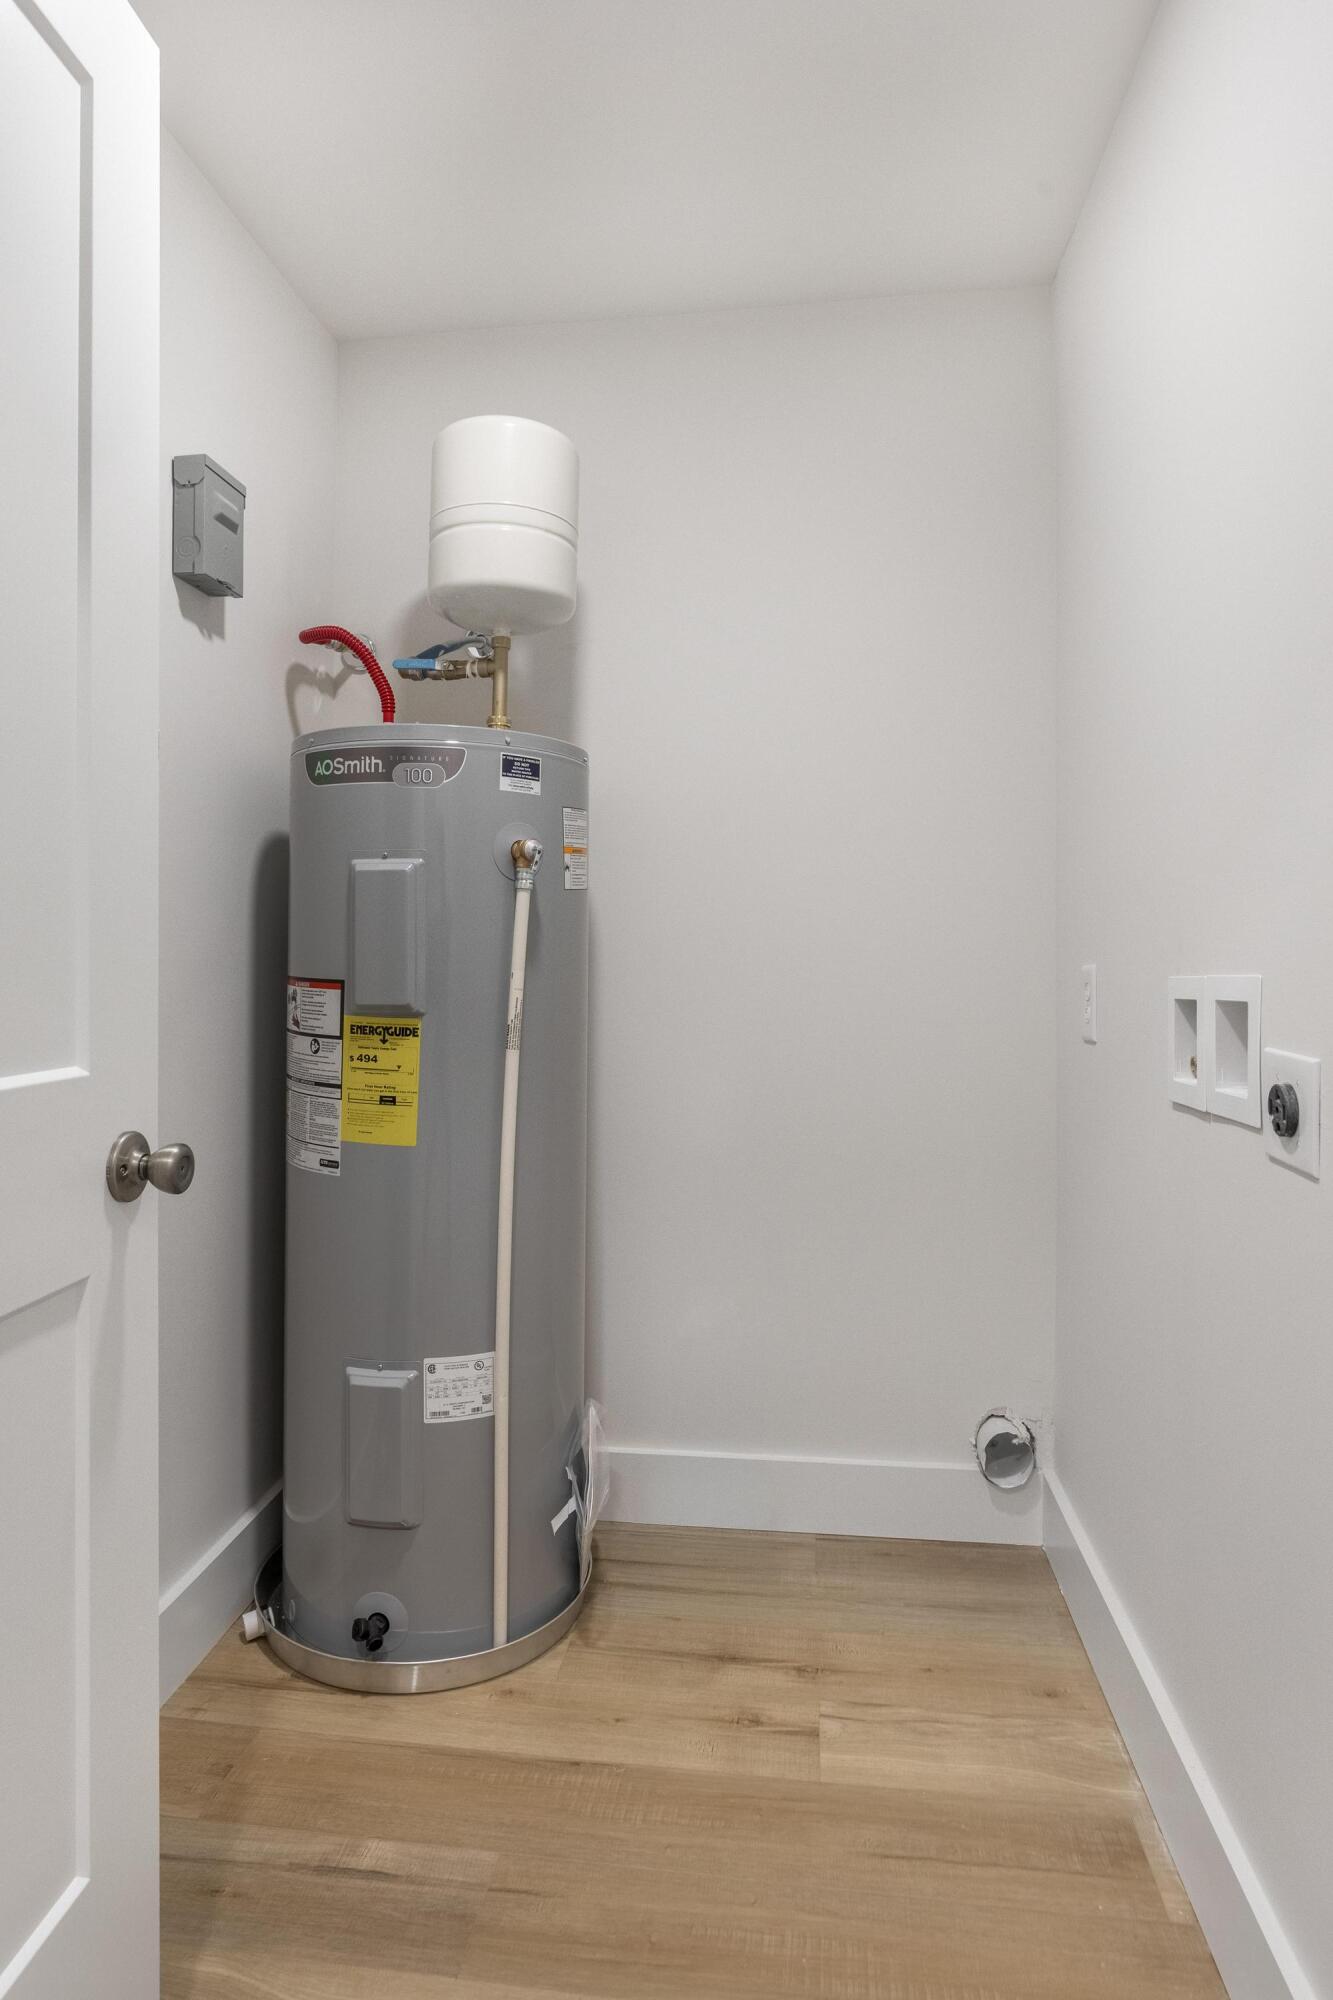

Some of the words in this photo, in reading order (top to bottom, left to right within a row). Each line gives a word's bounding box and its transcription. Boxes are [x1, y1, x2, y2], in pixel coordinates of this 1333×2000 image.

[404, 767, 434, 784] 100
[350, 1024, 419, 1038] ENERGYGUIDE
[356, 1053, 378, 1064] 494
